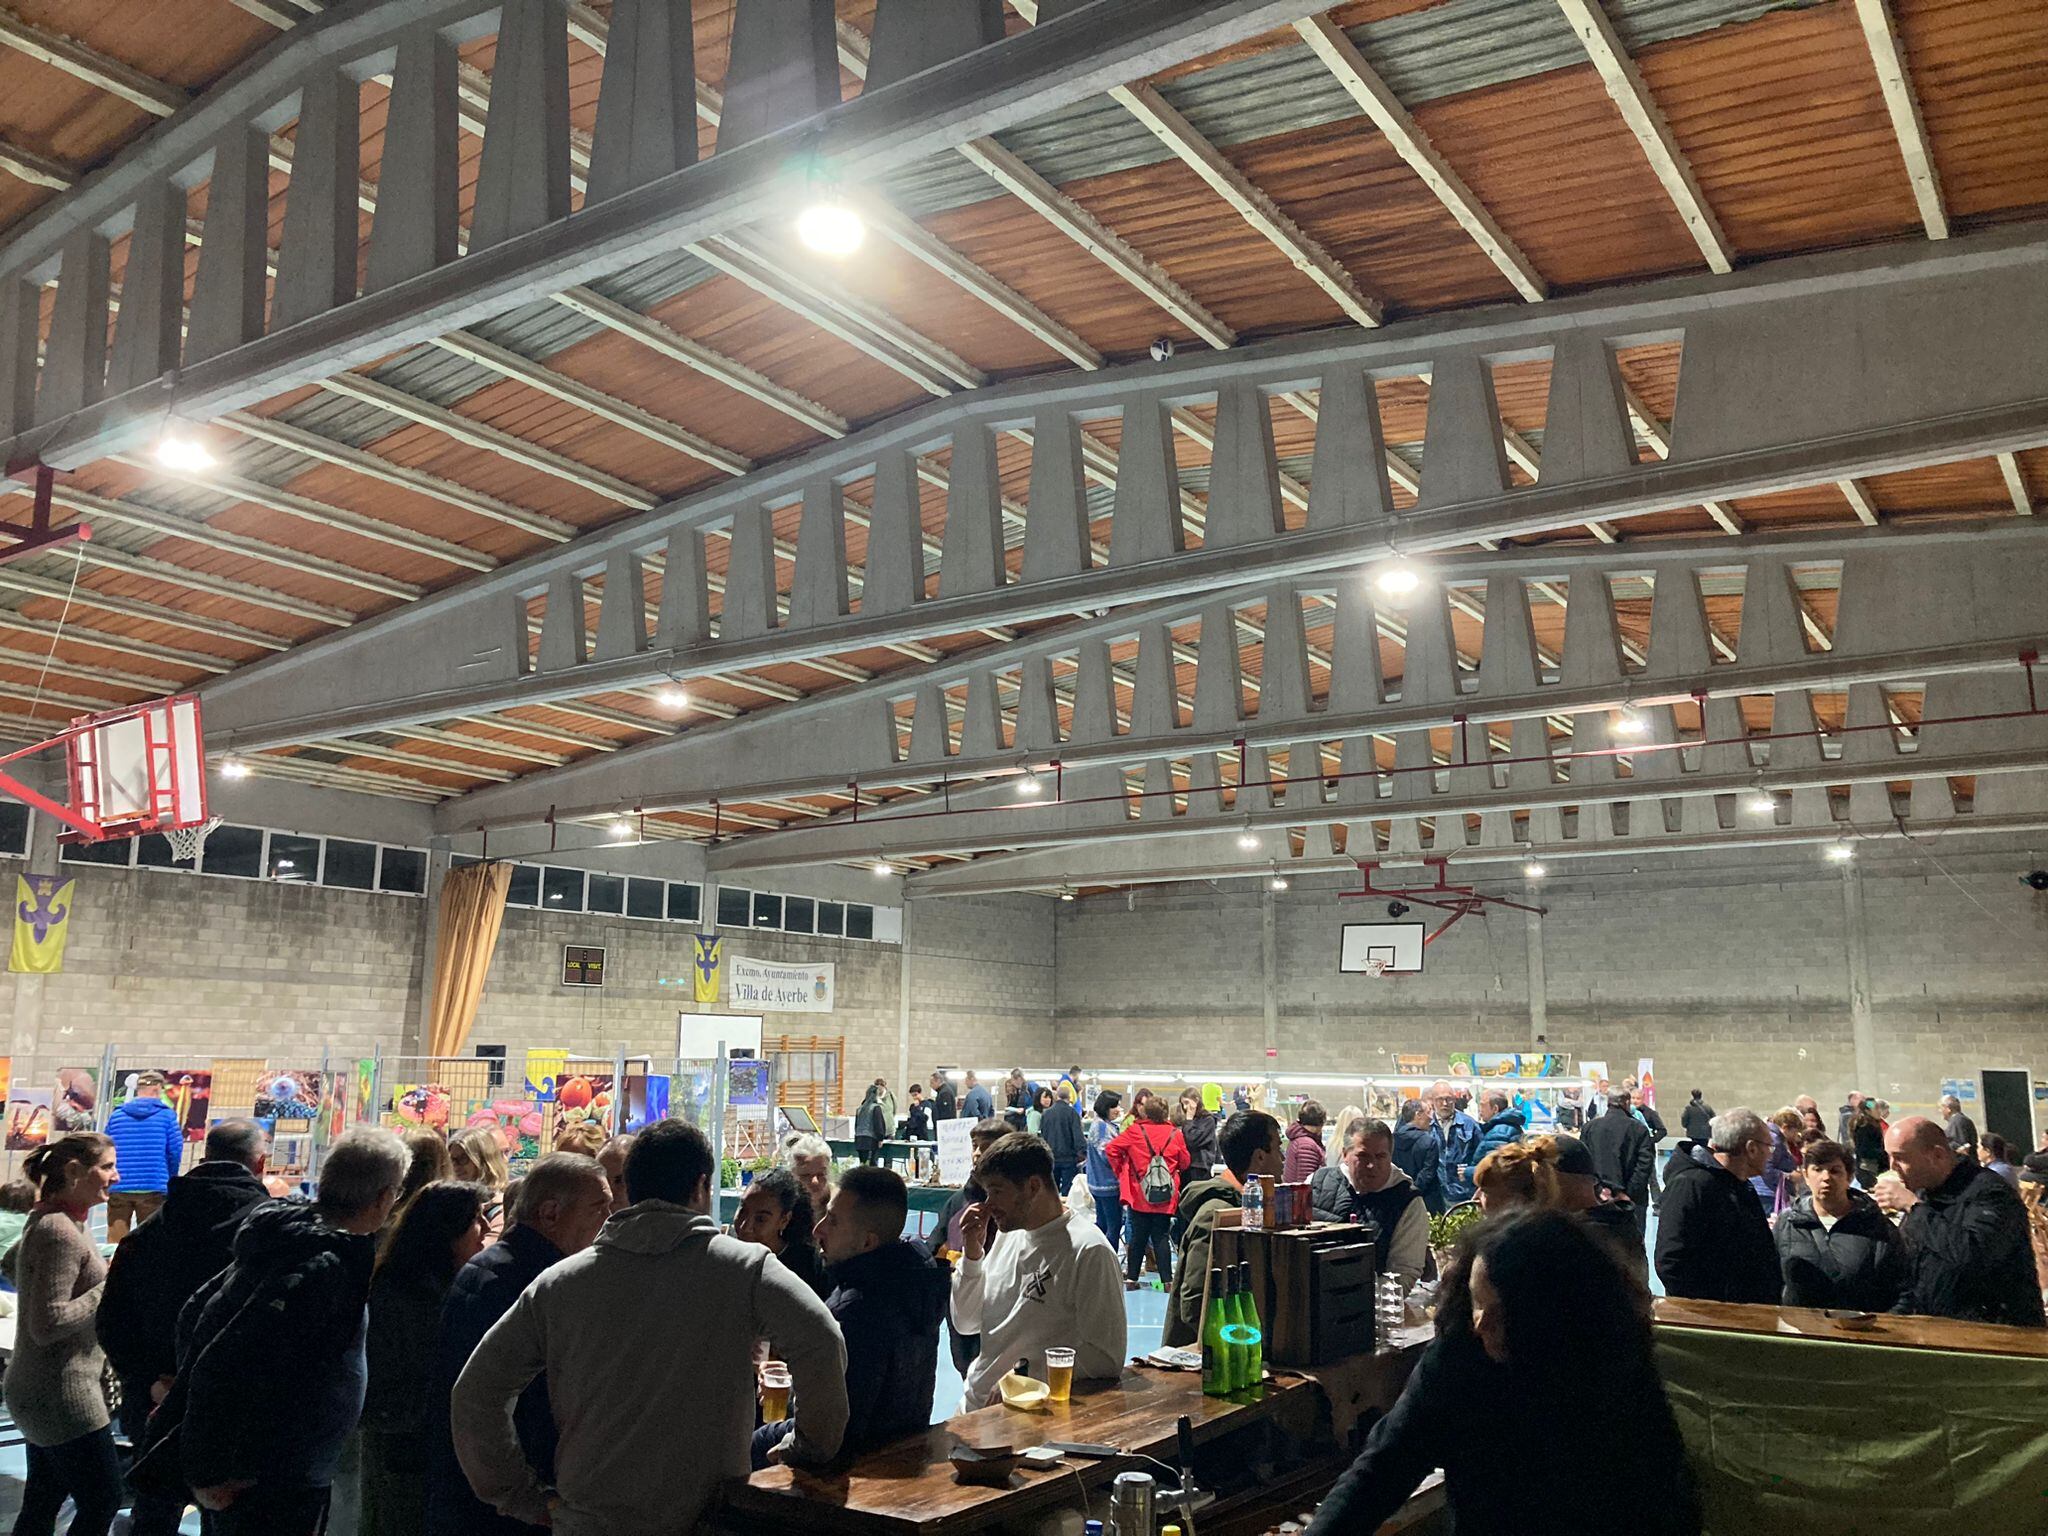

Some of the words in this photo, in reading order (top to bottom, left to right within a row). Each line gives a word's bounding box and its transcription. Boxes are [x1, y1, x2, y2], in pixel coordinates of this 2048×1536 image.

[567, 961, 581, 969] LOCAL
[763, 967, 809, 982] Ayuntamiento
[735, 983, 758, 1001] Villa
[761, 986, 773, 1002] de
[775, 988, 808, 1007] Ayerbe
